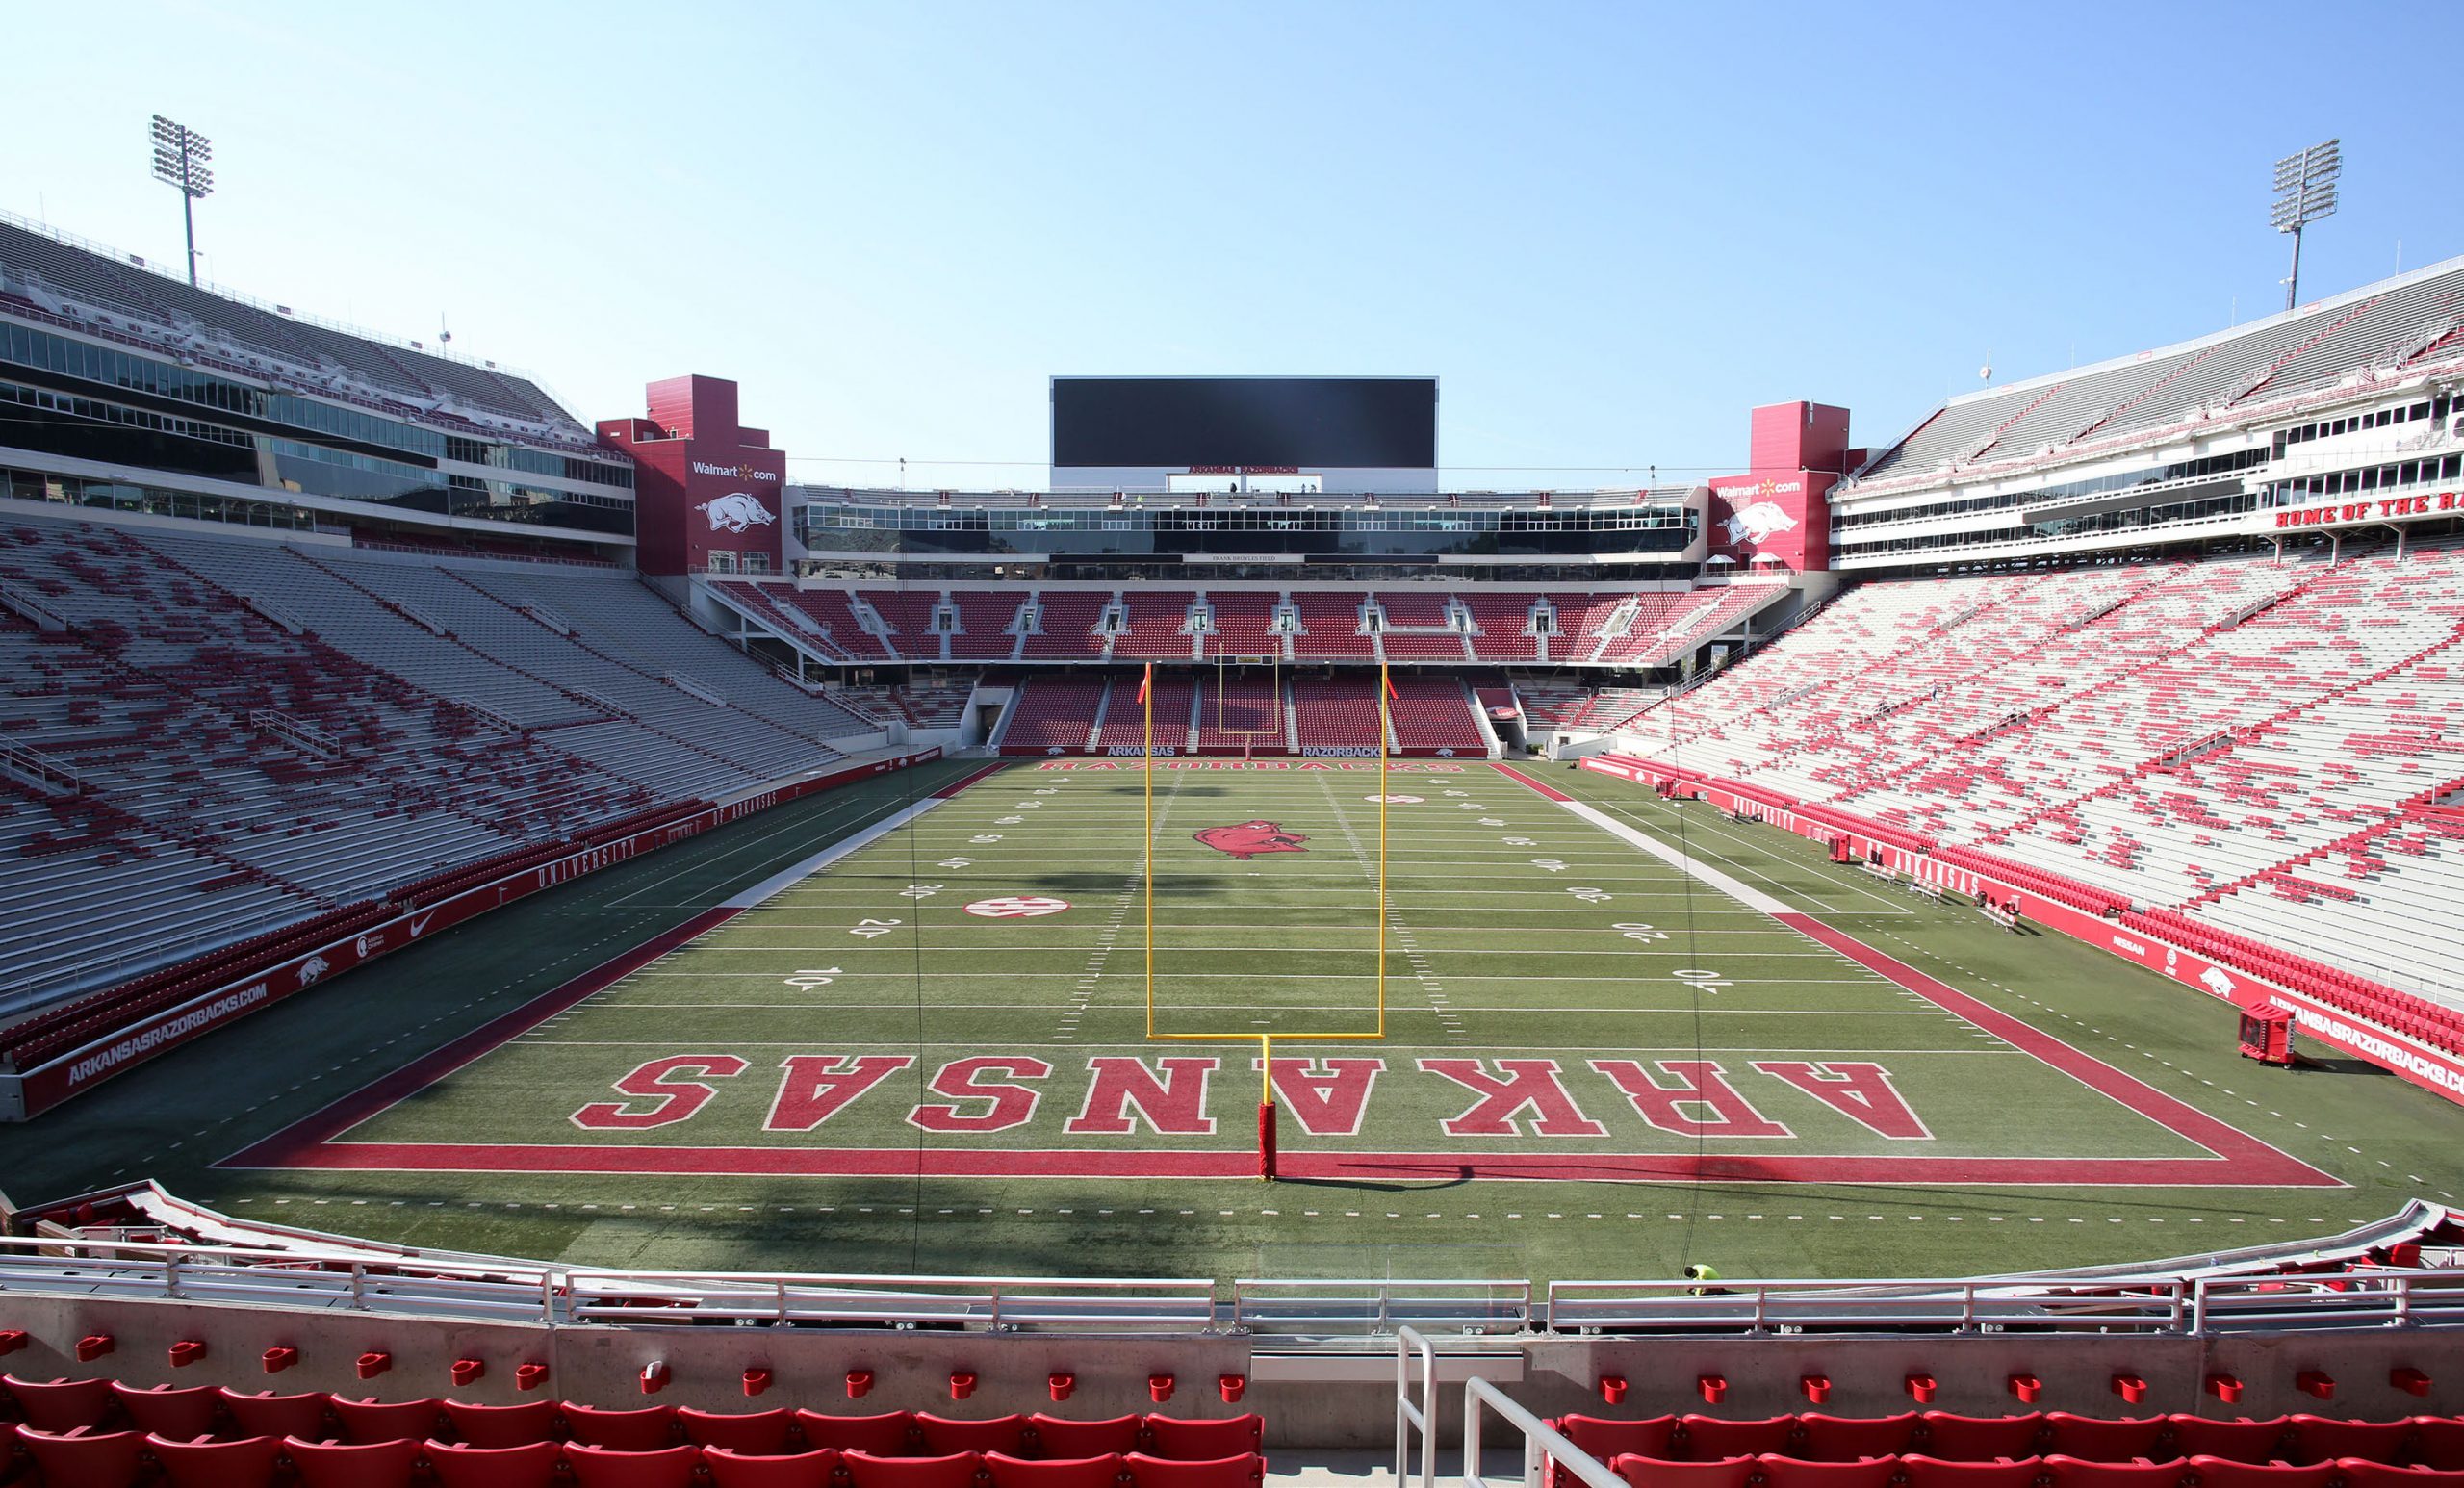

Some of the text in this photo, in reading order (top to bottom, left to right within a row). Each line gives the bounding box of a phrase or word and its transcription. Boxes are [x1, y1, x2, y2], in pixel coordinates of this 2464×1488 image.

[693, 462, 776, 481] Walmart com
[1716, 482, 1800, 498] Walmart com
[2275, 506, 2338, 527] HOME
[2341, 502, 2372, 521] OF
[2378, 495, 2430, 517] THE
[1107, 746, 1175, 757] ARKANSAS
[539, 791, 777, 888] UNIVERSITY OF ARKANSAS
[1895, 851, 1979, 897] ARKANSAS
[899, 884, 944, 897] 30
[1566, 886, 1612, 901] 30
[849, 918, 902, 936] 20
[1610, 922, 1670, 942] 20
[2113, 935, 2145, 957] NISSAN
[783, 966, 843, 986] 10
[1672, 969, 1733, 988] 10
[68, 983, 267, 1086] ARKANSASRAZORBACKS.COM
[568, 1055, 1936, 1141] ARKANSAS
